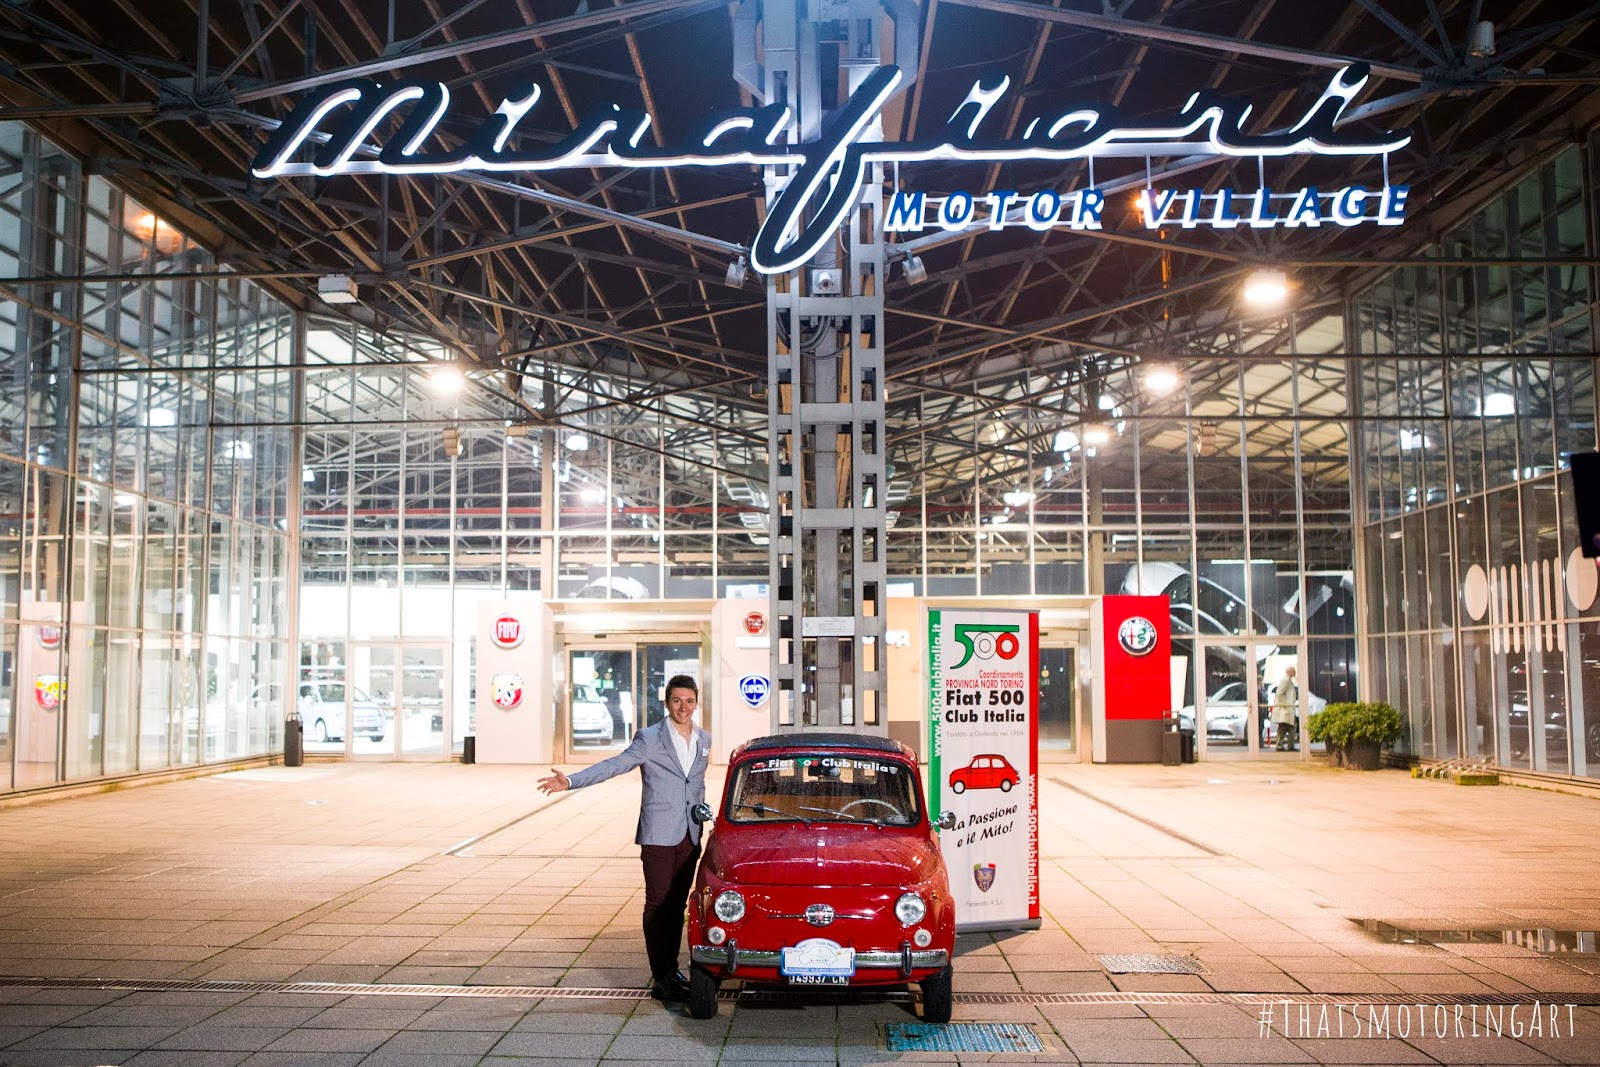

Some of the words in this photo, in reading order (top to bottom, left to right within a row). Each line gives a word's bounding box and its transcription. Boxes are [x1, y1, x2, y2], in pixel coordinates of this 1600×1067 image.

[252, 63, 1413, 274] Mirafiori
[884, 189, 1105, 231] MOTOR
[1140, 185, 1411, 229] VILLAGE
[498, 621, 519, 639] FIAT
[950, 624, 1020, 670] 500
[946, 680, 979, 688] PROVINCIA
[981, 680, 998, 688] NORD
[1000, 680, 1024, 688] TORINO
[979, 670, 1024, 679] Coordinamento
[931, 624, 941, 757] www.500clubitalia.it
[946, 689, 982, 706] Fiat
[988, 690, 1025, 706] 500
[945, 709, 978, 723] Club
[984, 709, 1025, 722] Italia
[768, 758, 795, 769] Fiat
[821, 758, 851, 769] Club
[853, 760, 889, 774] Italia
[968, 804, 1018, 827] Passione
[956, 838, 963, 848] e
[966, 831, 976, 845] il
[979, 821, 1014, 841] Mito!
[1028, 774, 1038, 905] www.500clubitalia.it
